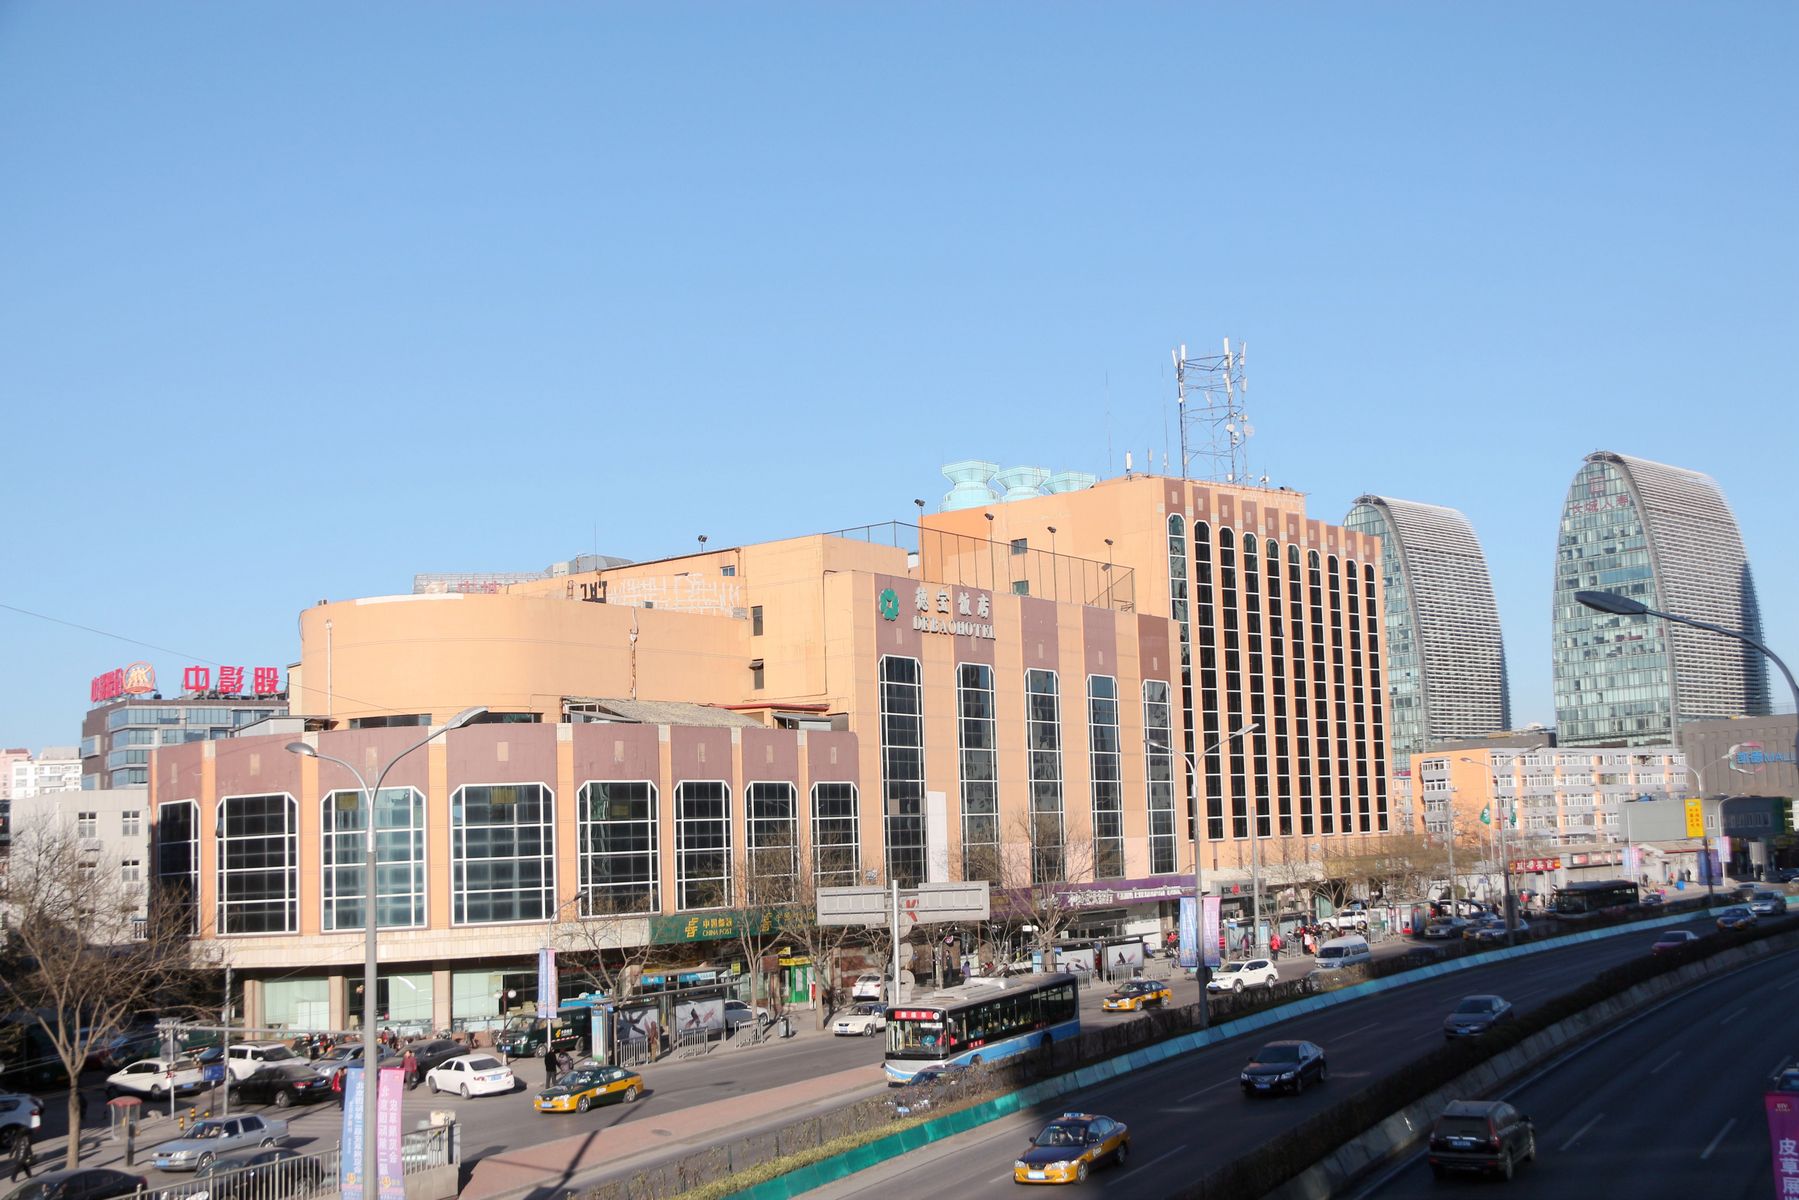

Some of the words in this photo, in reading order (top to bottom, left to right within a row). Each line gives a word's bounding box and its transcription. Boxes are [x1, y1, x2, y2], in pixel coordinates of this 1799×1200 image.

[1571, 494, 1629, 513] 长城人寿
[702, 917, 733, 929] 中国邮政
[702, 929, 719, 937] CHINA
[719, 928, 732, 936] POST
